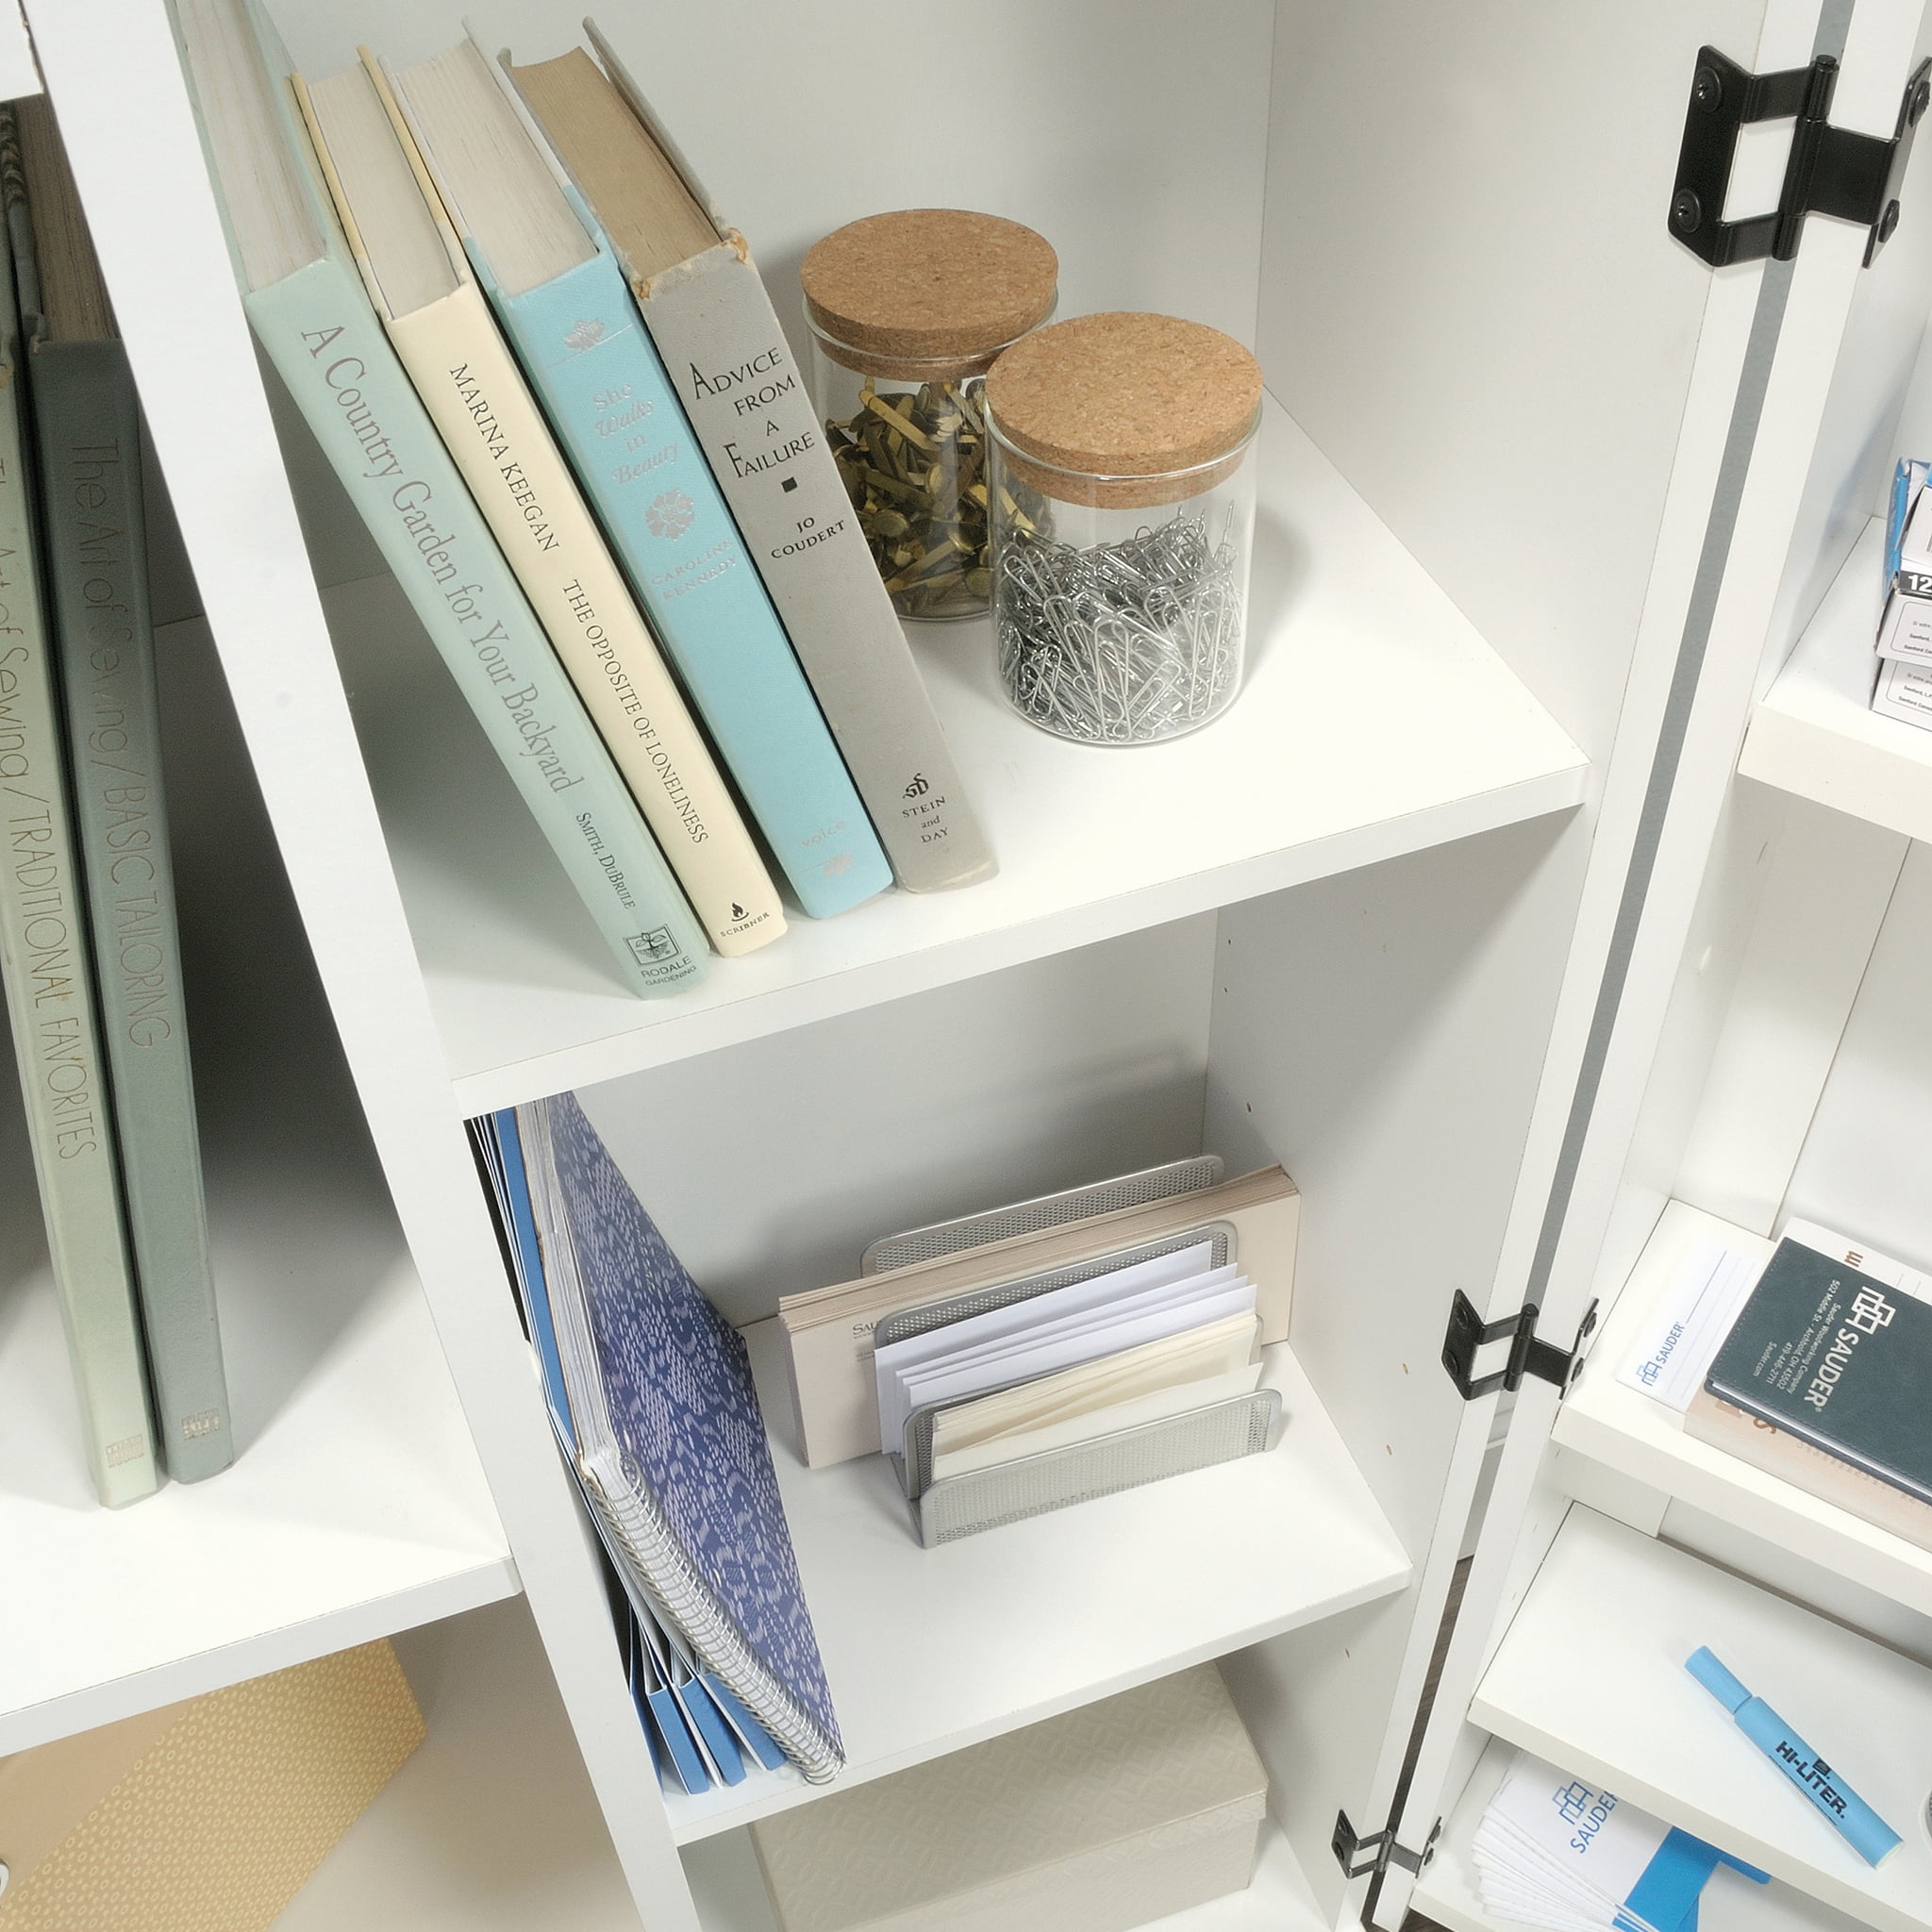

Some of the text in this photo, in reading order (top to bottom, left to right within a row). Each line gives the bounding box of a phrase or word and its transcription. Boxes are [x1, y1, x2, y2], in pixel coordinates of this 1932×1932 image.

[689, 347, 783, 400] ADVICE
[592, 384, 633, 412] She
[734, 375, 796, 416] FROM
[595, 400, 655, 438] Walks
[765, 420, 780, 437] A
[450, 363, 559, 552] MARINA KEEGAN
[624, 434, 648, 453] in
[723, 432, 815, 478] FAILURE
[72, 438, 120, 510] The
[611, 443, 678, 485] Beauty
[77, 521, 121, 565] Art
[771, 520, 845, 558] COUDERT
[796, 517, 815, 533] JO
[300, 325, 585, 793] A Country Garden for Your Backyard
[82, 577, 128, 611] of
[662, 558, 737, 601] KENNEDY
[563, 579, 708, 843] THE OPPOSITE OF LONELINESS
[902, 796, 945, 818] STEIN
[921, 816, 941, 828] and
[105, 787, 155, 885] BASIC
[802, 821, 845, 847] voice
[921, 827, 949, 843] DAY
[8, 809, 74, 1008] TRADITIONAL
[720, 912, 770, 937] SCRIBNER
[115, 891, 171, 1047] TAILORING
[641, 956, 692, 978] RODALE
[645, 965, 697, 986] GARDENING
[40, 1018, 96, 1158] FAVORITES
[1824, 1303, 1840, 1325] Sauder
[1787, 1365, 1808, 1394] Company
